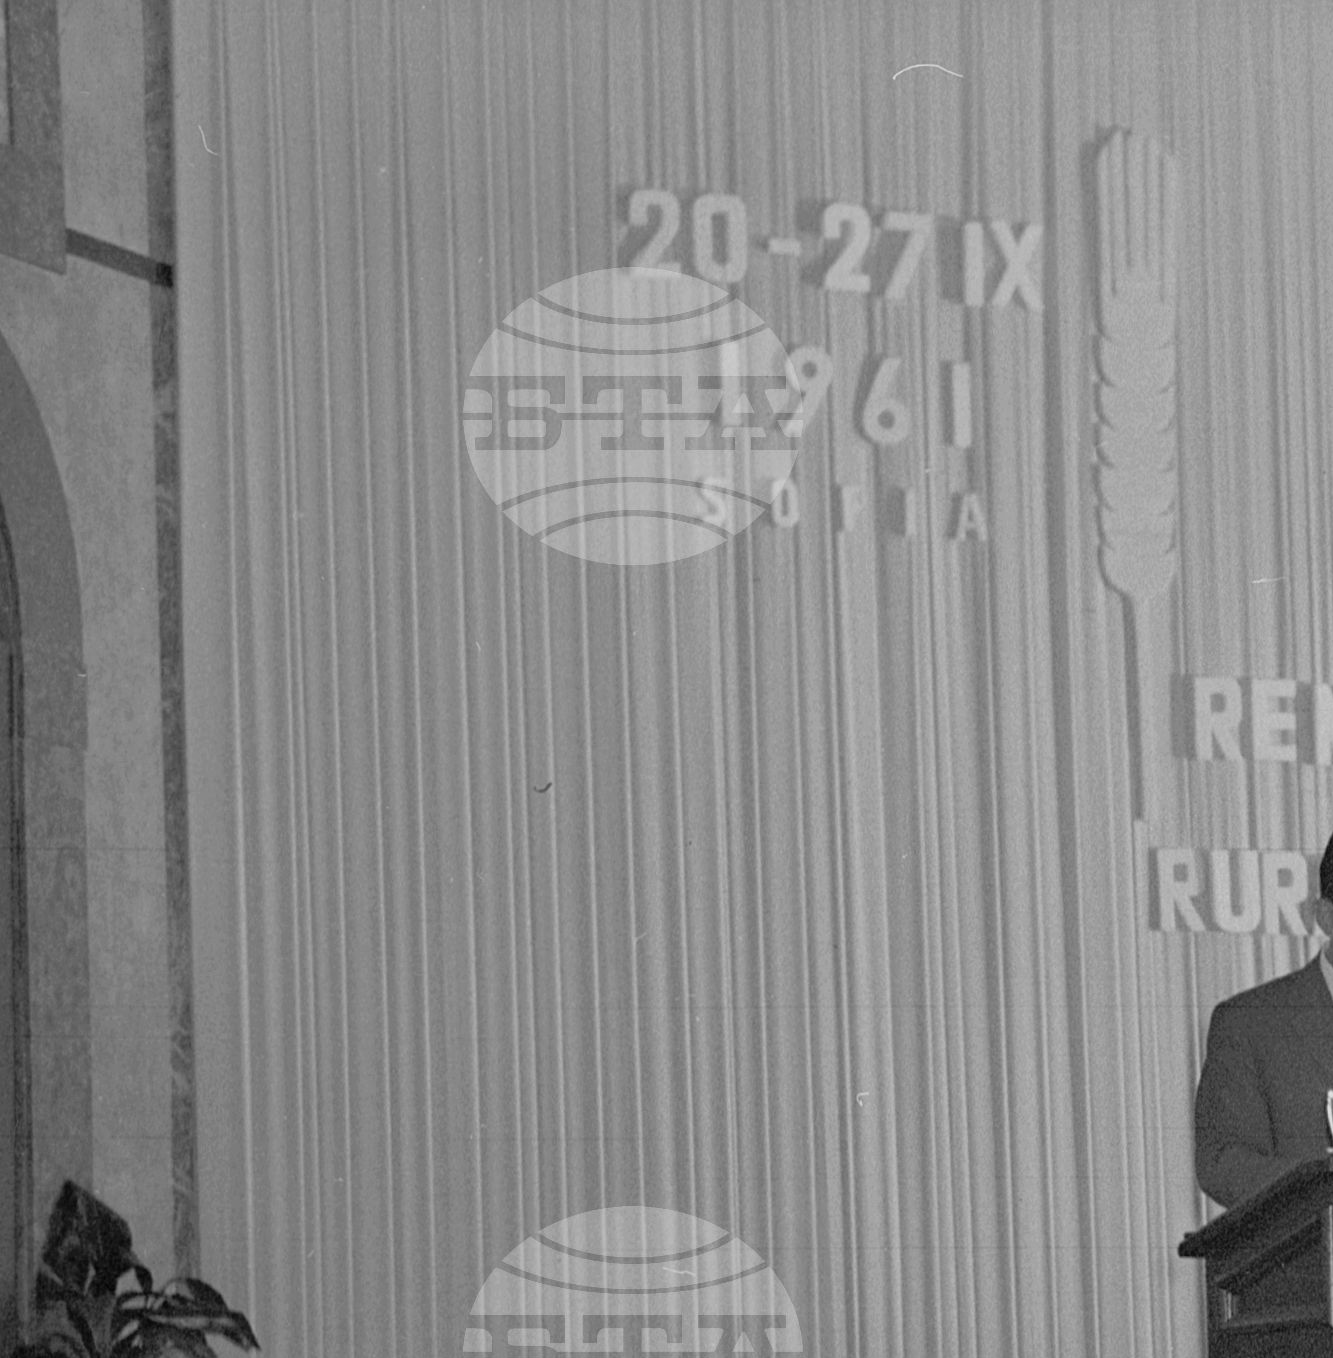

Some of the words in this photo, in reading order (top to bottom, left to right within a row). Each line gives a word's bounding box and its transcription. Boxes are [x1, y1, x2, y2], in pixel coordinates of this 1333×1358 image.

[628, 189, 935, 302] 20-27
[961, 219, 1045, 312] IX
[719, 342, 971, 450] 1961
